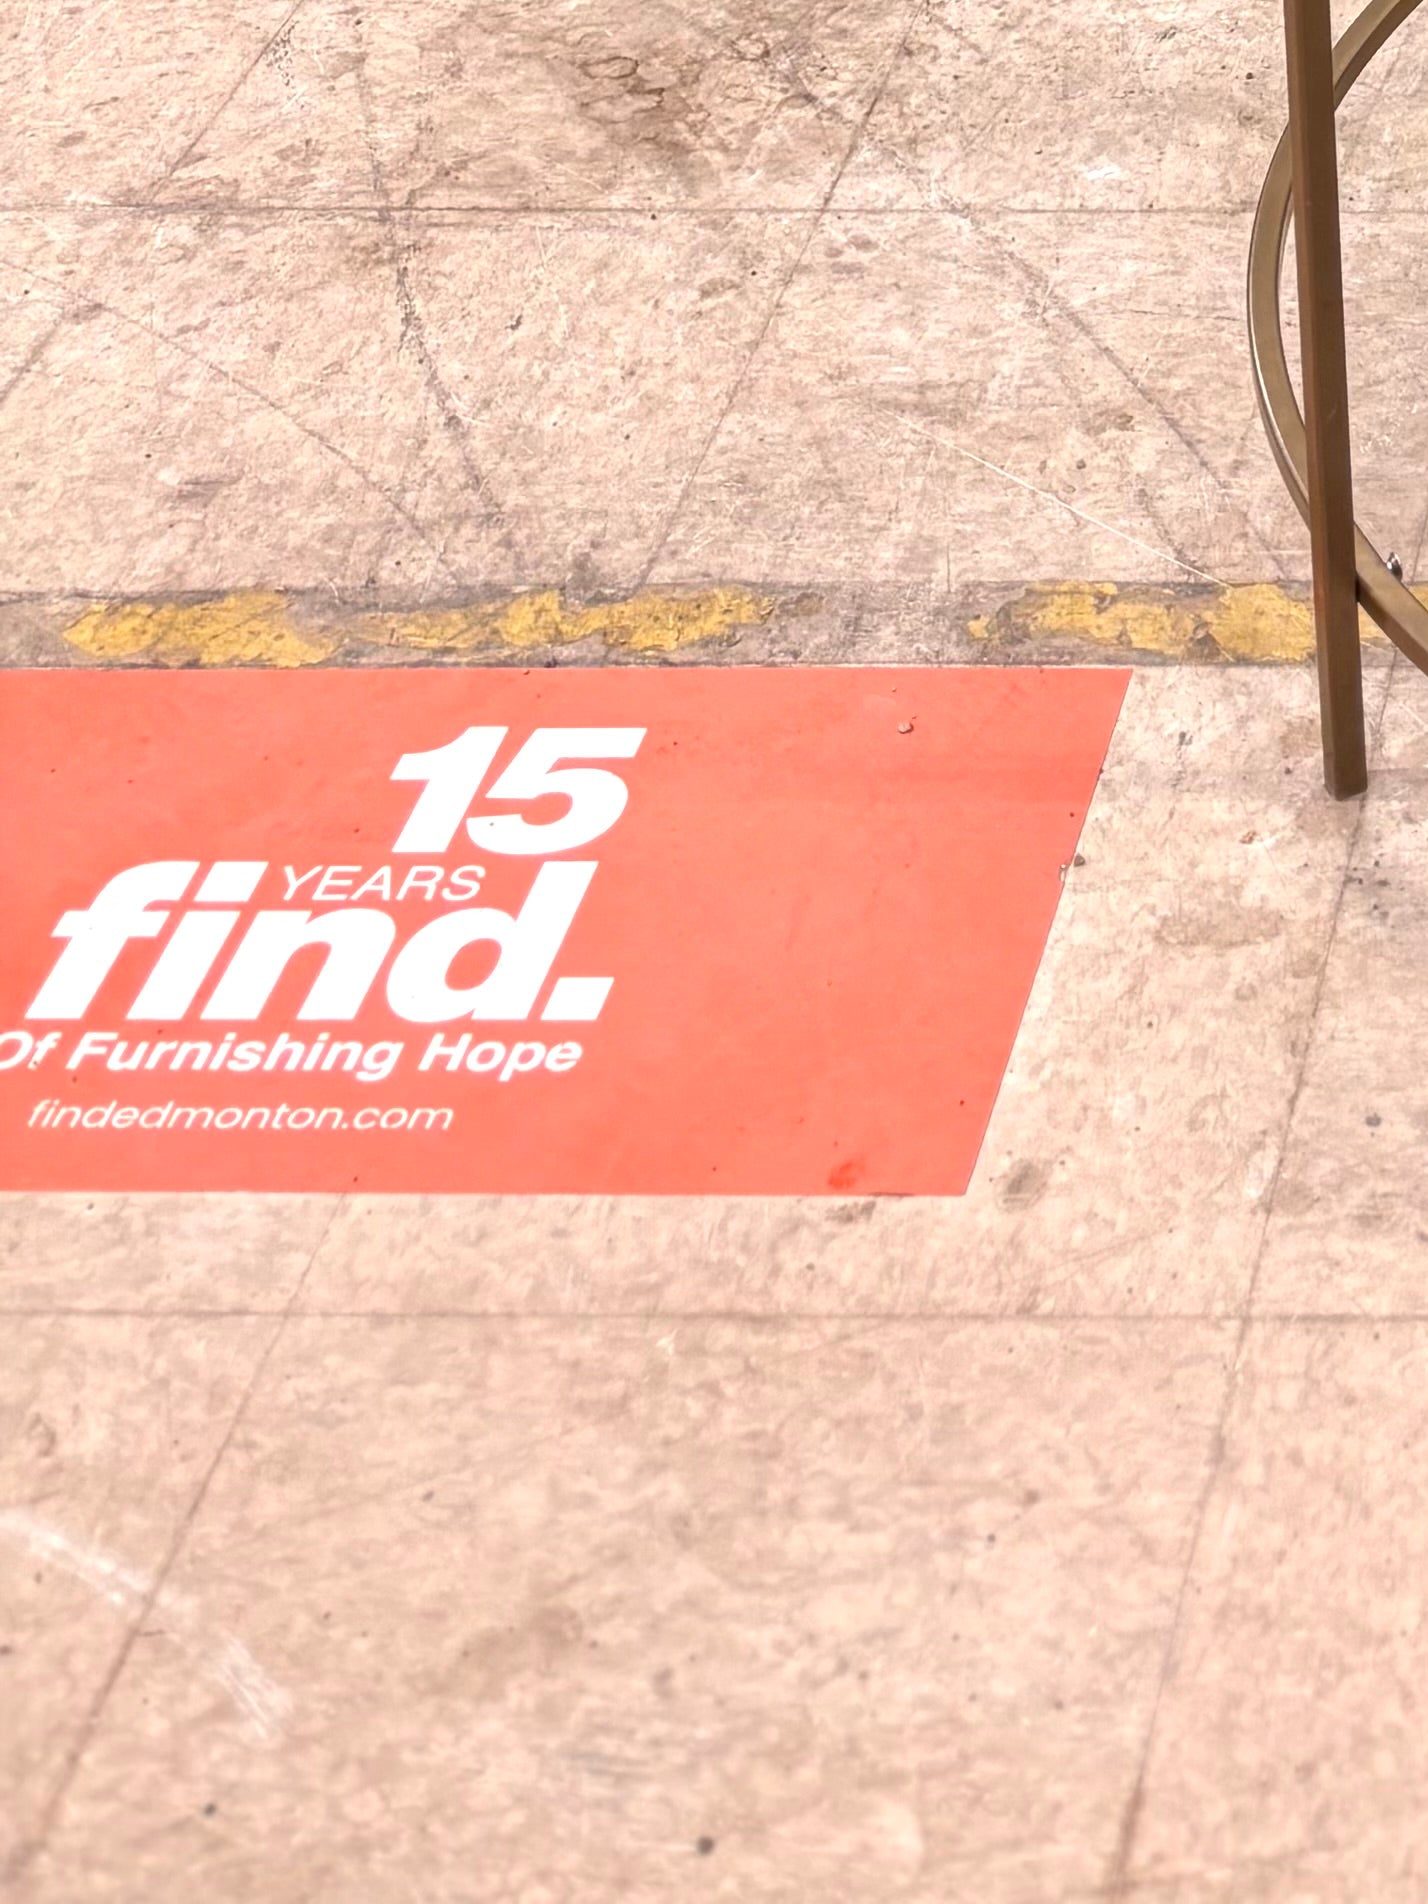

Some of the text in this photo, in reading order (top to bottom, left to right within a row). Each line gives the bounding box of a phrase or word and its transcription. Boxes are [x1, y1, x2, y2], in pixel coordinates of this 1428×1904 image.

[389, 725, 647, 855] 15
[281, 865, 486, 903] YEARS
[24, 859, 615, 1023] find.
[0, 1031, 583, 1083] Of Furnishing Hope
[27, 1099, 454, 1130] findedmonton.com
